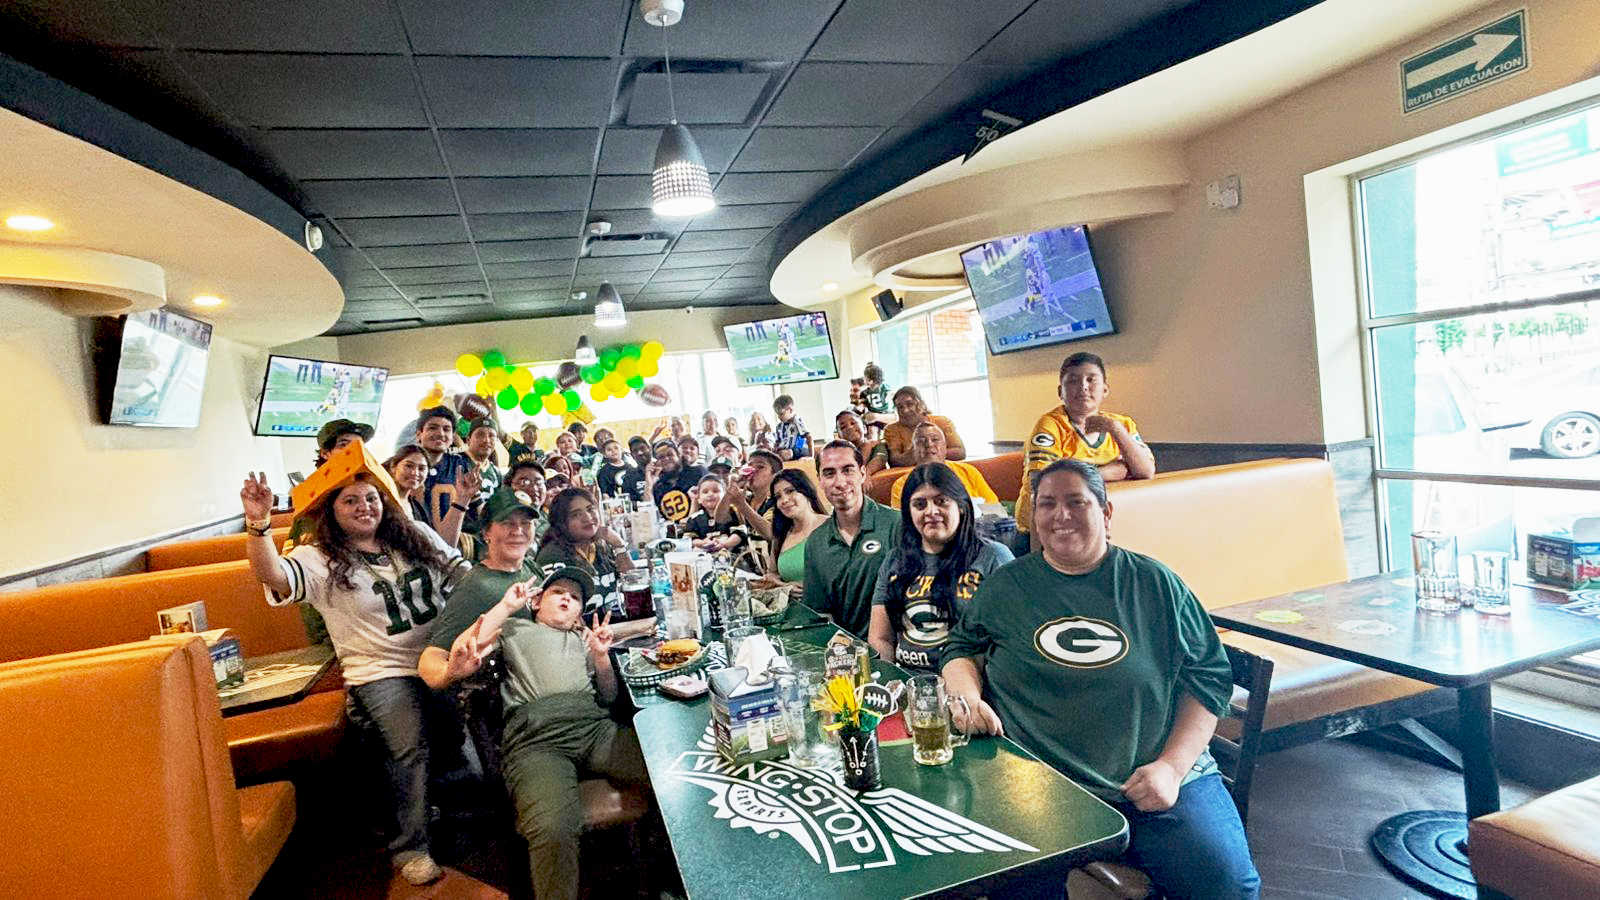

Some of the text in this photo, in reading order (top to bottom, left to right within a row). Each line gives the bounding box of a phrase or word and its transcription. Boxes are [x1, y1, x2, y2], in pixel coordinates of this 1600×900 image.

[1407, 57, 1522, 107] RUTA DE EVACUACION
[662, 495, 687, 517] 52
[371, 566, 438, 636] 10
[1034, 616, 1129, 668] G
[737, 789, 786, 818] EXPERTS
